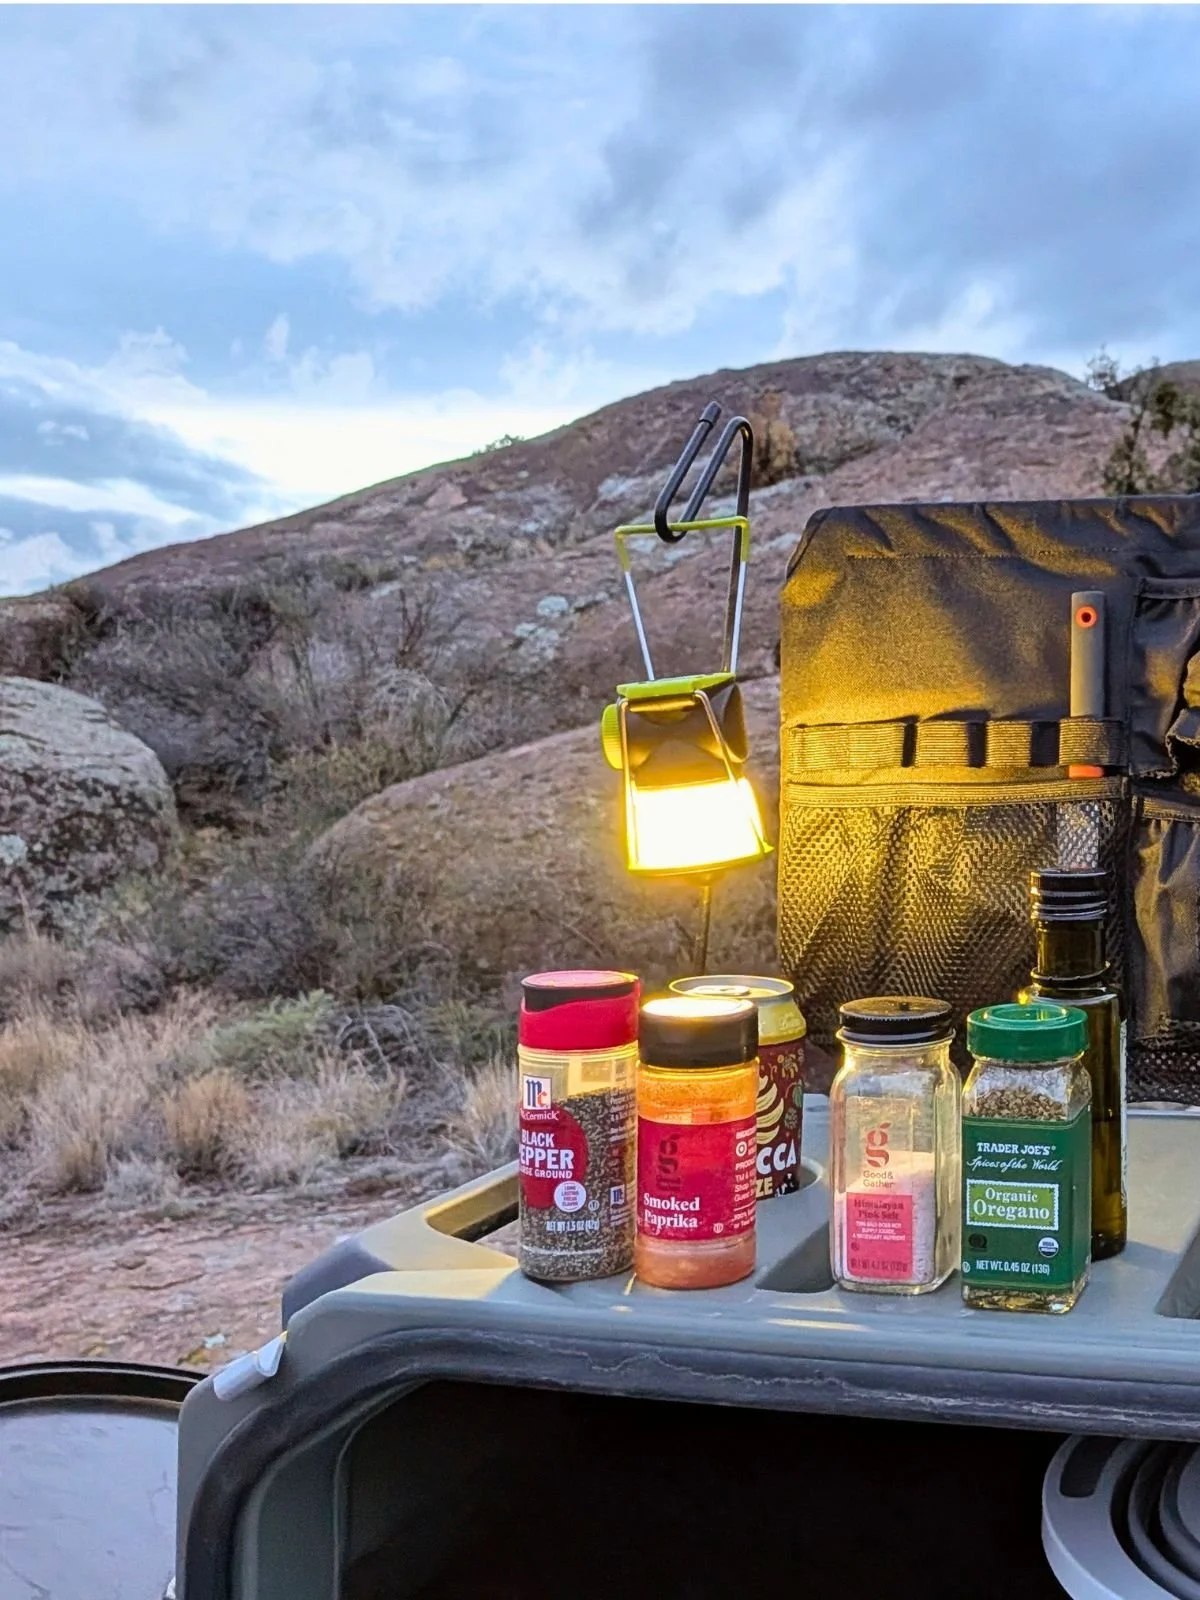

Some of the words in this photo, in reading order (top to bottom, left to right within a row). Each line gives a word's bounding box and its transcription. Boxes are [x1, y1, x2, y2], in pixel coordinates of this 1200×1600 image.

[521, 1129, 555, 1148] BLACK
[976, 1142, 1019, 1154] TRADER
[519, 1143, 575, 1170] EPPER
[756, 1138, 796, 1175] CCA
[967, 1155, 1000, 1172] Spices
[1032, 1159, 1063, 1171] World
[534, 1168, 573, 1179] GROUND
[756, 1177, 773, 1197] ZE
[985, 1187, 1038, 1203] Organic
[643, 1192, 700, 1211] Smoked
[854, 1199, 905, 1211] Himalayan
[973, 1199, 1050, 1221] Oregano
[644, 1209, 698, 1231] Paprika
[976, 1260, 989, 1270] NET
[990, 1261, 1003, 1271] WT.
[1020, 1263, 1030, 1273] OZ
[1031, 1263, 1050, 1276] (13G)
